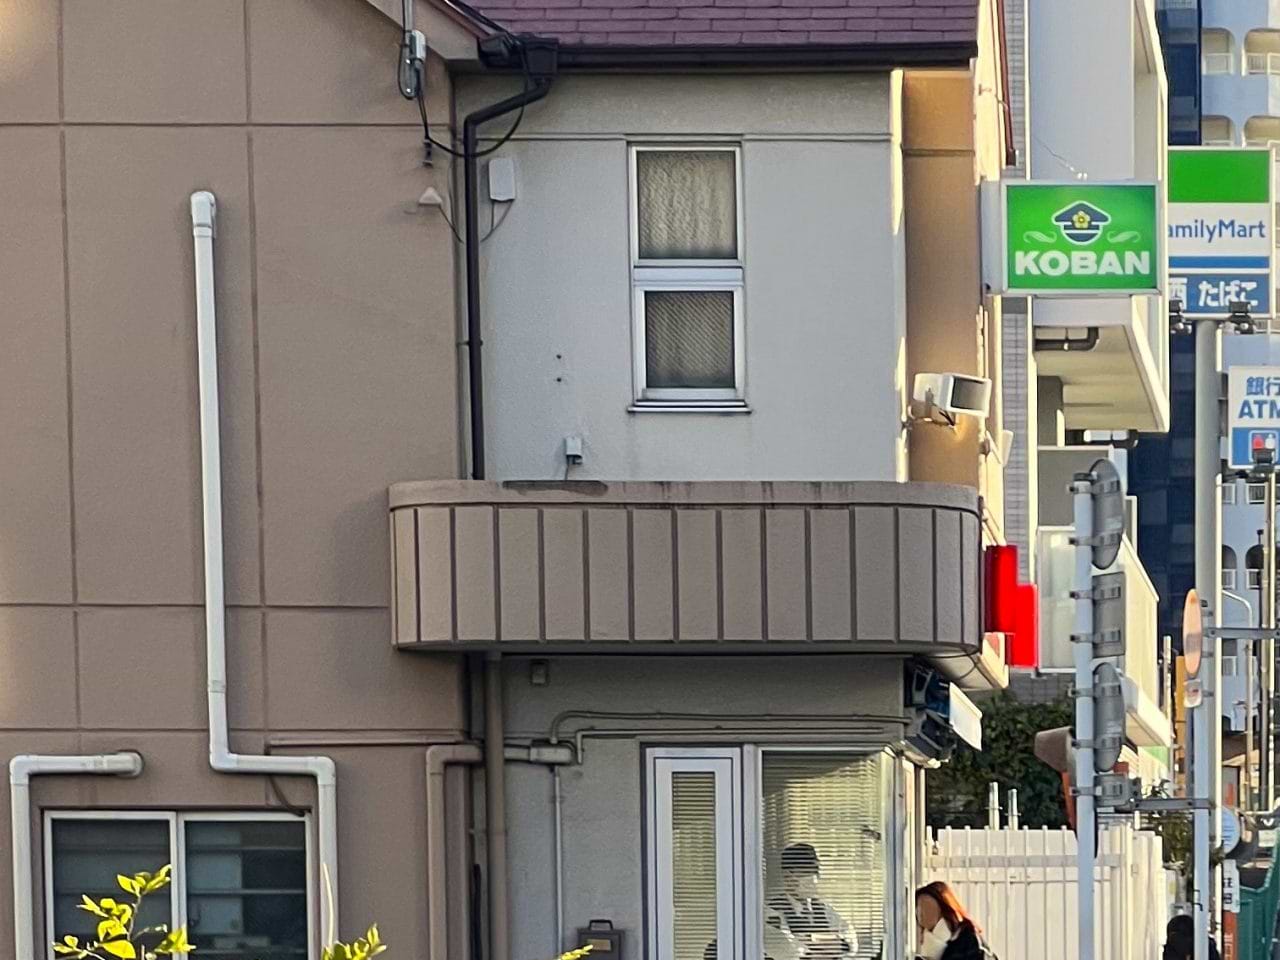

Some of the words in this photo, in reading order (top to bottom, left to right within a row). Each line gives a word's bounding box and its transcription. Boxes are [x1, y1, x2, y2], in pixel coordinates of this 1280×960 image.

[1168, 218, 1266, 243] amilyMart
[1015, 249, 1150, 276] KOBAN
[1198, 279, 1258, 308] たばこ
